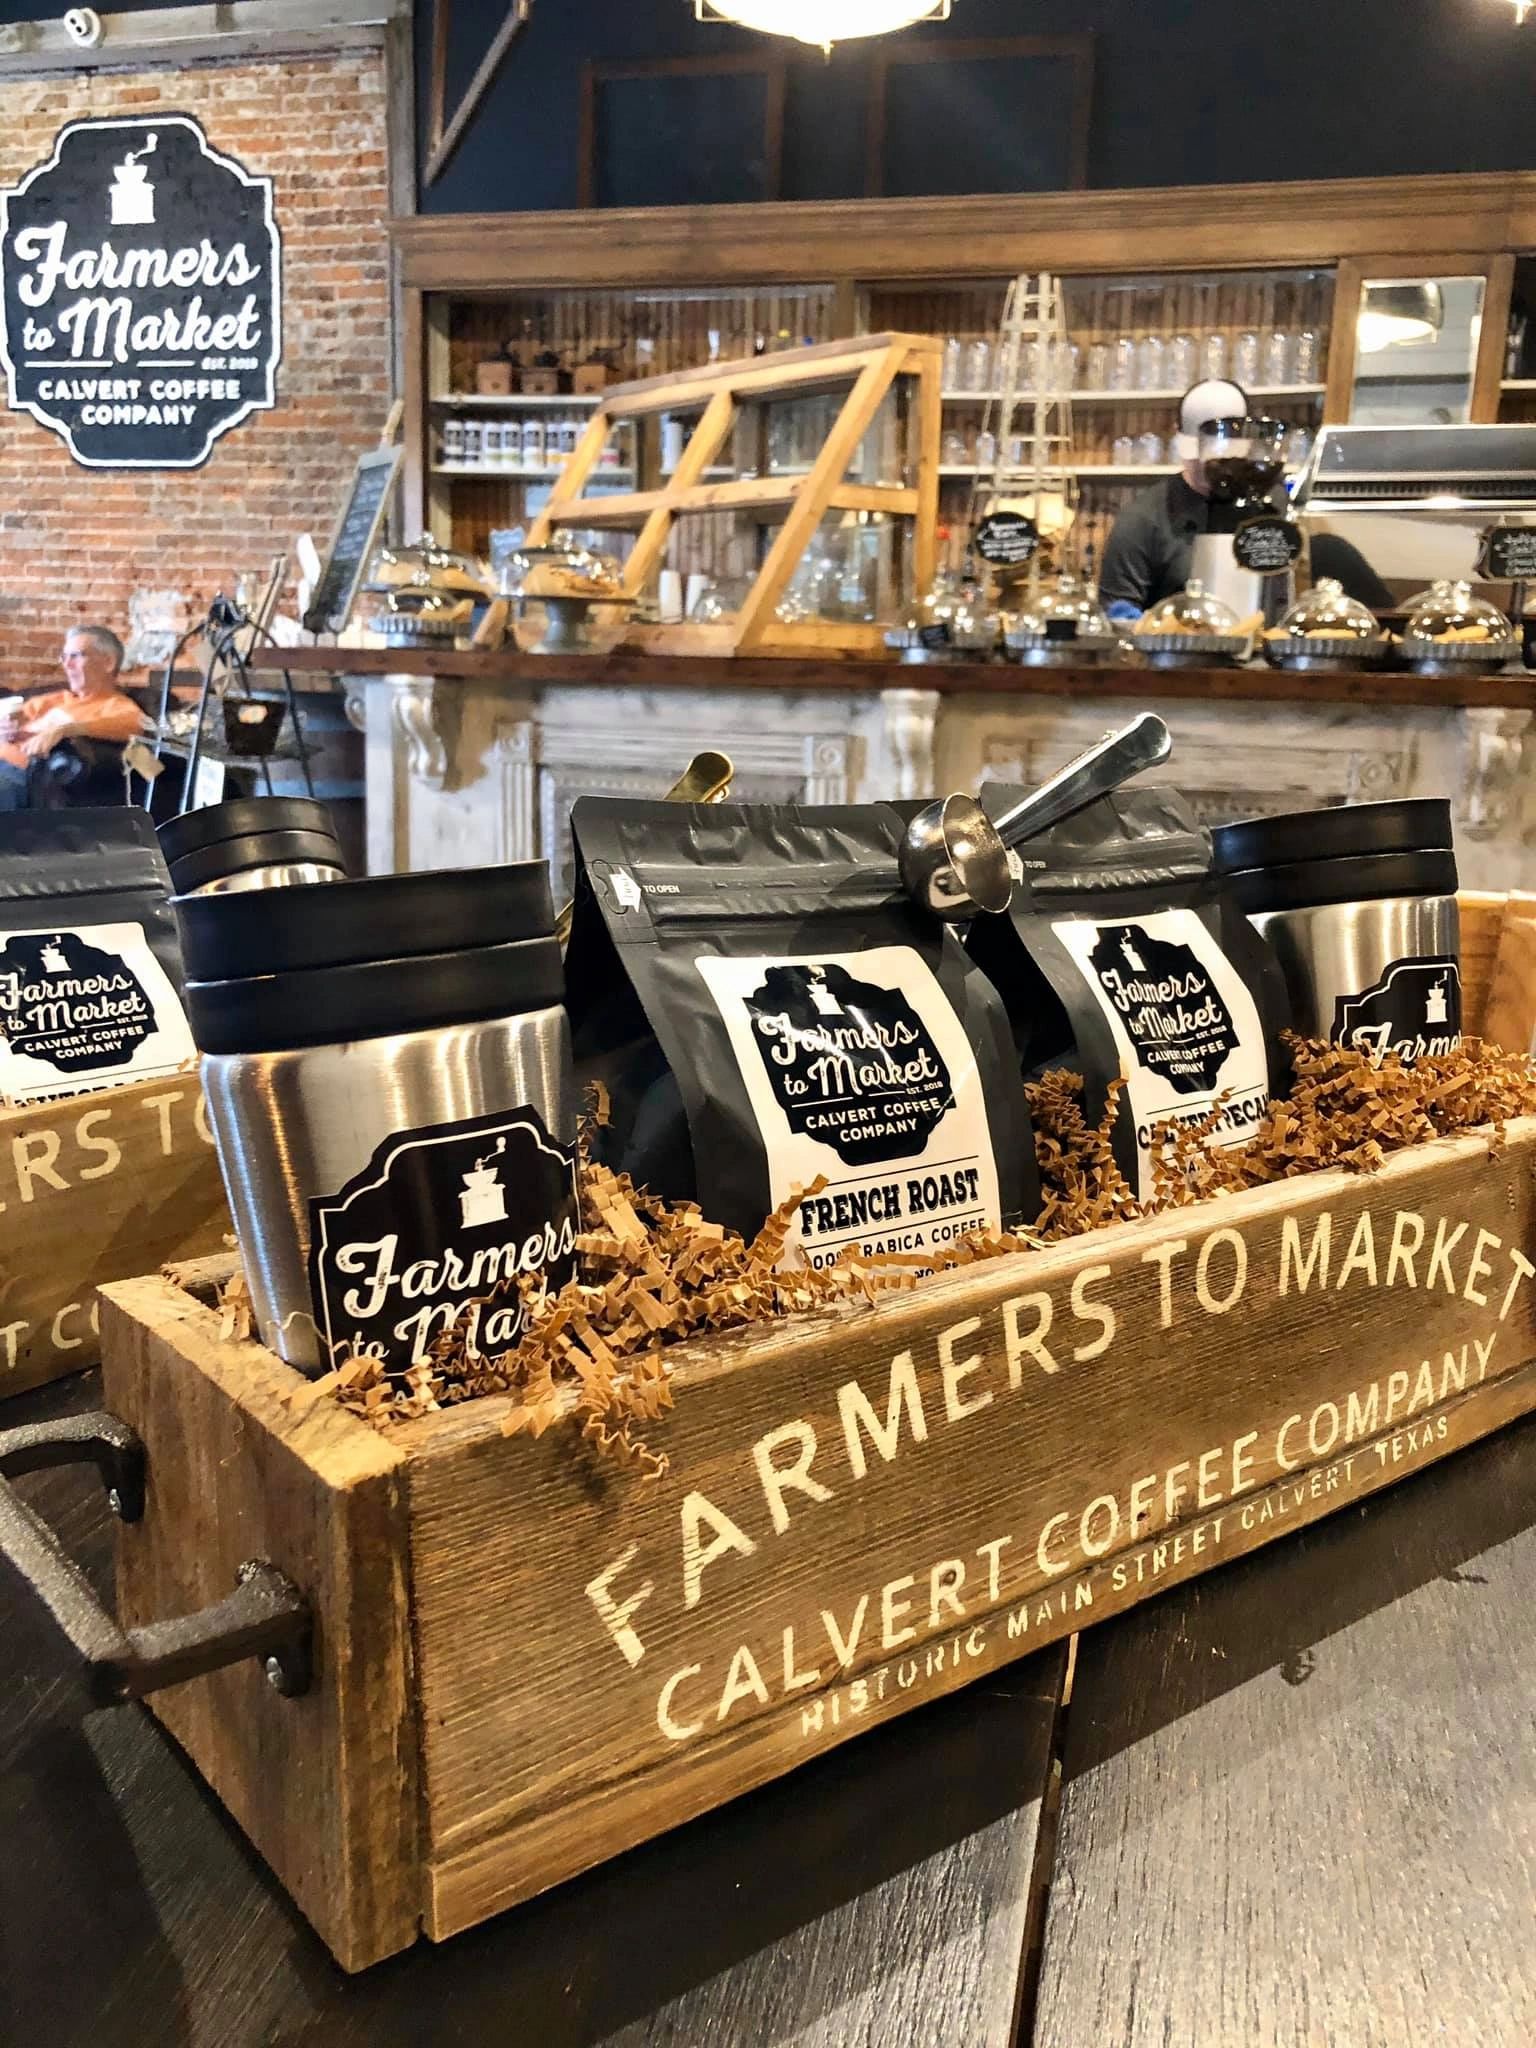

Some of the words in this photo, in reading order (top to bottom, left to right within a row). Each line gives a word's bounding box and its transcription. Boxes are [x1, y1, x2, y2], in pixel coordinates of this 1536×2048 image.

[14, 221, 261, 307] Farmers
[23, 317, 56, 350] to
[58, 294, 261, 363] Market
[38, 379, 142, 400] CALVERT
[150, 379, 241, 400] COFFEE
[80, 405, 197, 425] COMPANY
[0, 972, 133, 1010] Farmers
[7, 1016, 28, 1031] to
[26, 991, 146, 1031] Market
[1101, 968, 1206, 1012] Farmers
[25, 1034, 87, 1052] CALVERT
[92, 1025, 144, 1042] COFFEE
[758, 1012, 919, 1065] Farmers
[1139, 996, 1222, 1042] Market
[56, 1041, 122, 1059] COMPANY
[784, 1074, 808, 1096] to
[808, 1048, 938, 1096] Market
[1181, 1040, 1226, 1060] COFFEE
[805, 1106, 877, 1129] CALVERT
[884, 1098, 941, 1117] COFFEE
[840, 1118, 917, 1142] COMPANY
[0, 1109, 121, 1211] RS
[800, 1184, 901, 1236] FRENCH
[907, 1168, 979, 1215] ROAST
[335, 1216, 577, 1318] Farmers
[863, 1232, 924, 1258] RABICA
[350, 1331, 390, 1360] to
[585, 1264, 1117, 1668] FARMERS
[1142, 1228, 1248, 1328] TO
[1279, 1210, 1536, 1320] MARKET
[656, 1535, 1012, 1739] CALVERT
[1037, 1430, 1258, 1576] COFFEE
[1276, 1332, 1497, 1471] COMPANY
[801, 1625, 986, 1737] HISTORIC
[1007, 1582, 1093, 1639] MAIN
[1112, 1518, 1224, 1591] STREET
[1241, 1457, 1354, 1530] CALVERT
[1375, 1416, 1449, 1467] TEXAS
